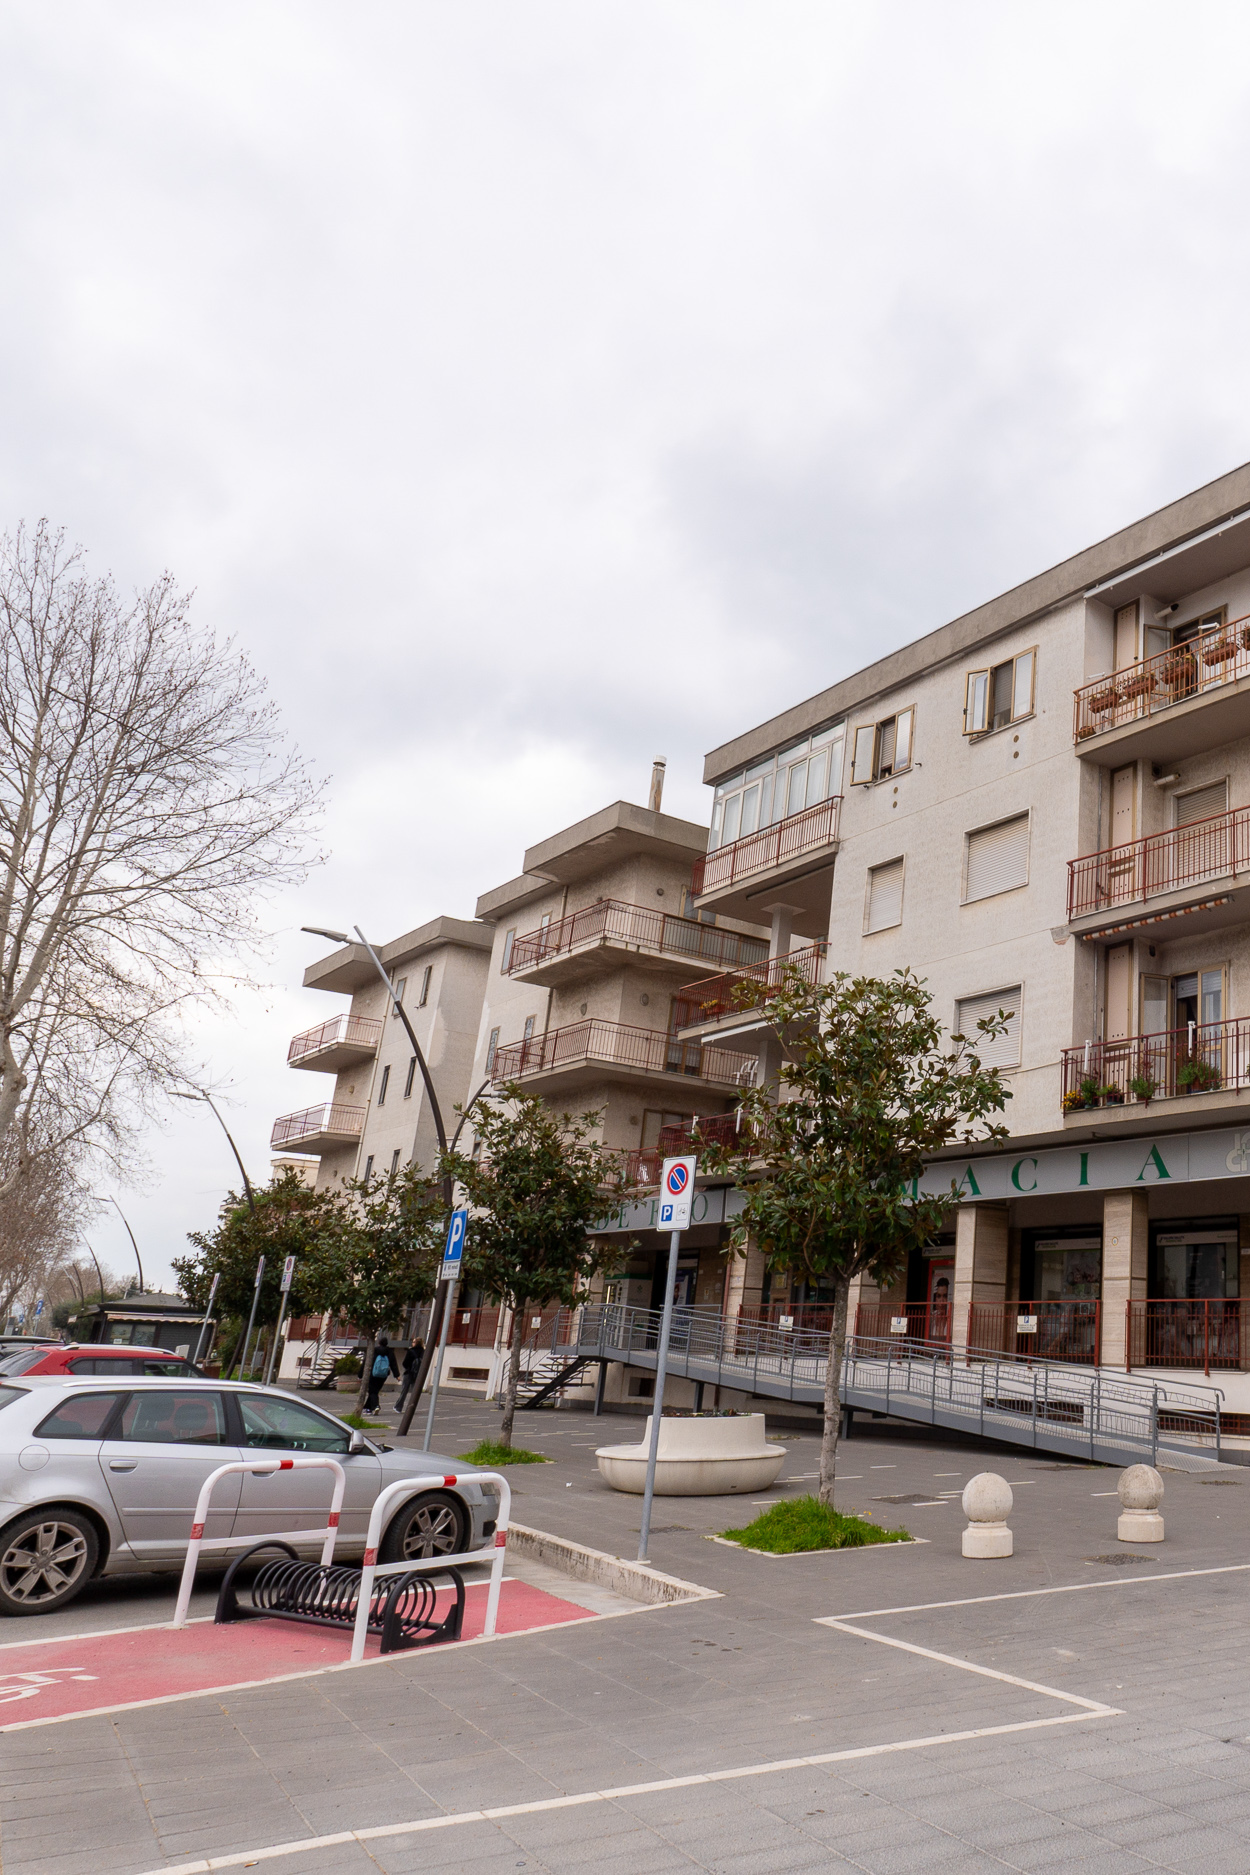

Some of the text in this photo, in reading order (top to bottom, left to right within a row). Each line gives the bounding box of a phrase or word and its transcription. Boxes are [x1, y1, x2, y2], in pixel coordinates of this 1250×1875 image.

[898, 1143, 1173, 1201] MACIA
[648, 1193, 709, 1227] FO
[664, 1206, 672, 1221] P
[447, 1217, 463, 1255] P
